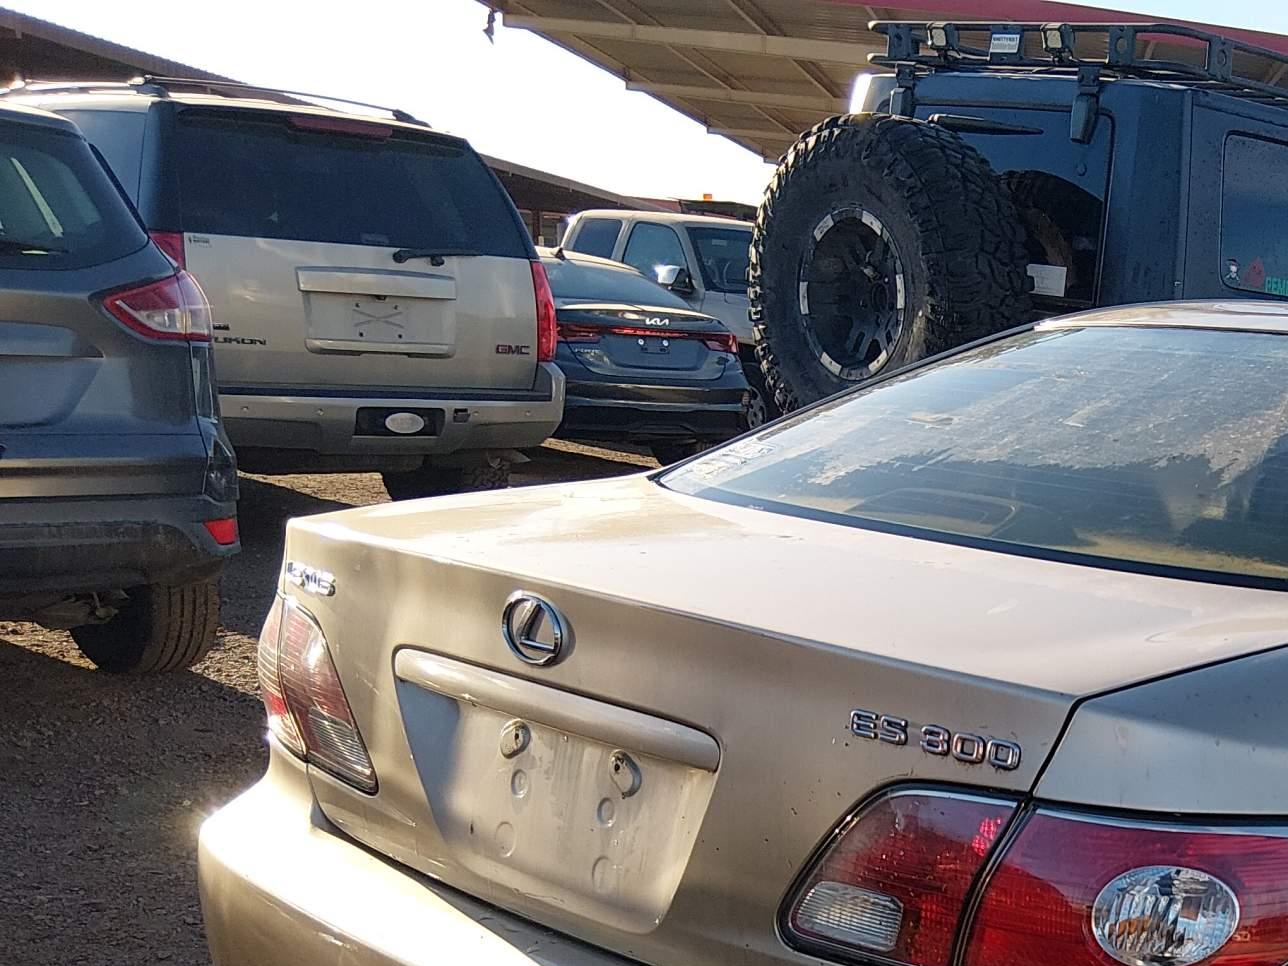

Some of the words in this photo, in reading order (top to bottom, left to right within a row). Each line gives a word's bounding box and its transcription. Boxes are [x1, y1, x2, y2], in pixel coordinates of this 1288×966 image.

[212, 336, 267, 346] UKON
[495, 343, 531, 356] GMC
[849, 708, 908, 746] ES
[918, 723, 1022, 771] 300
